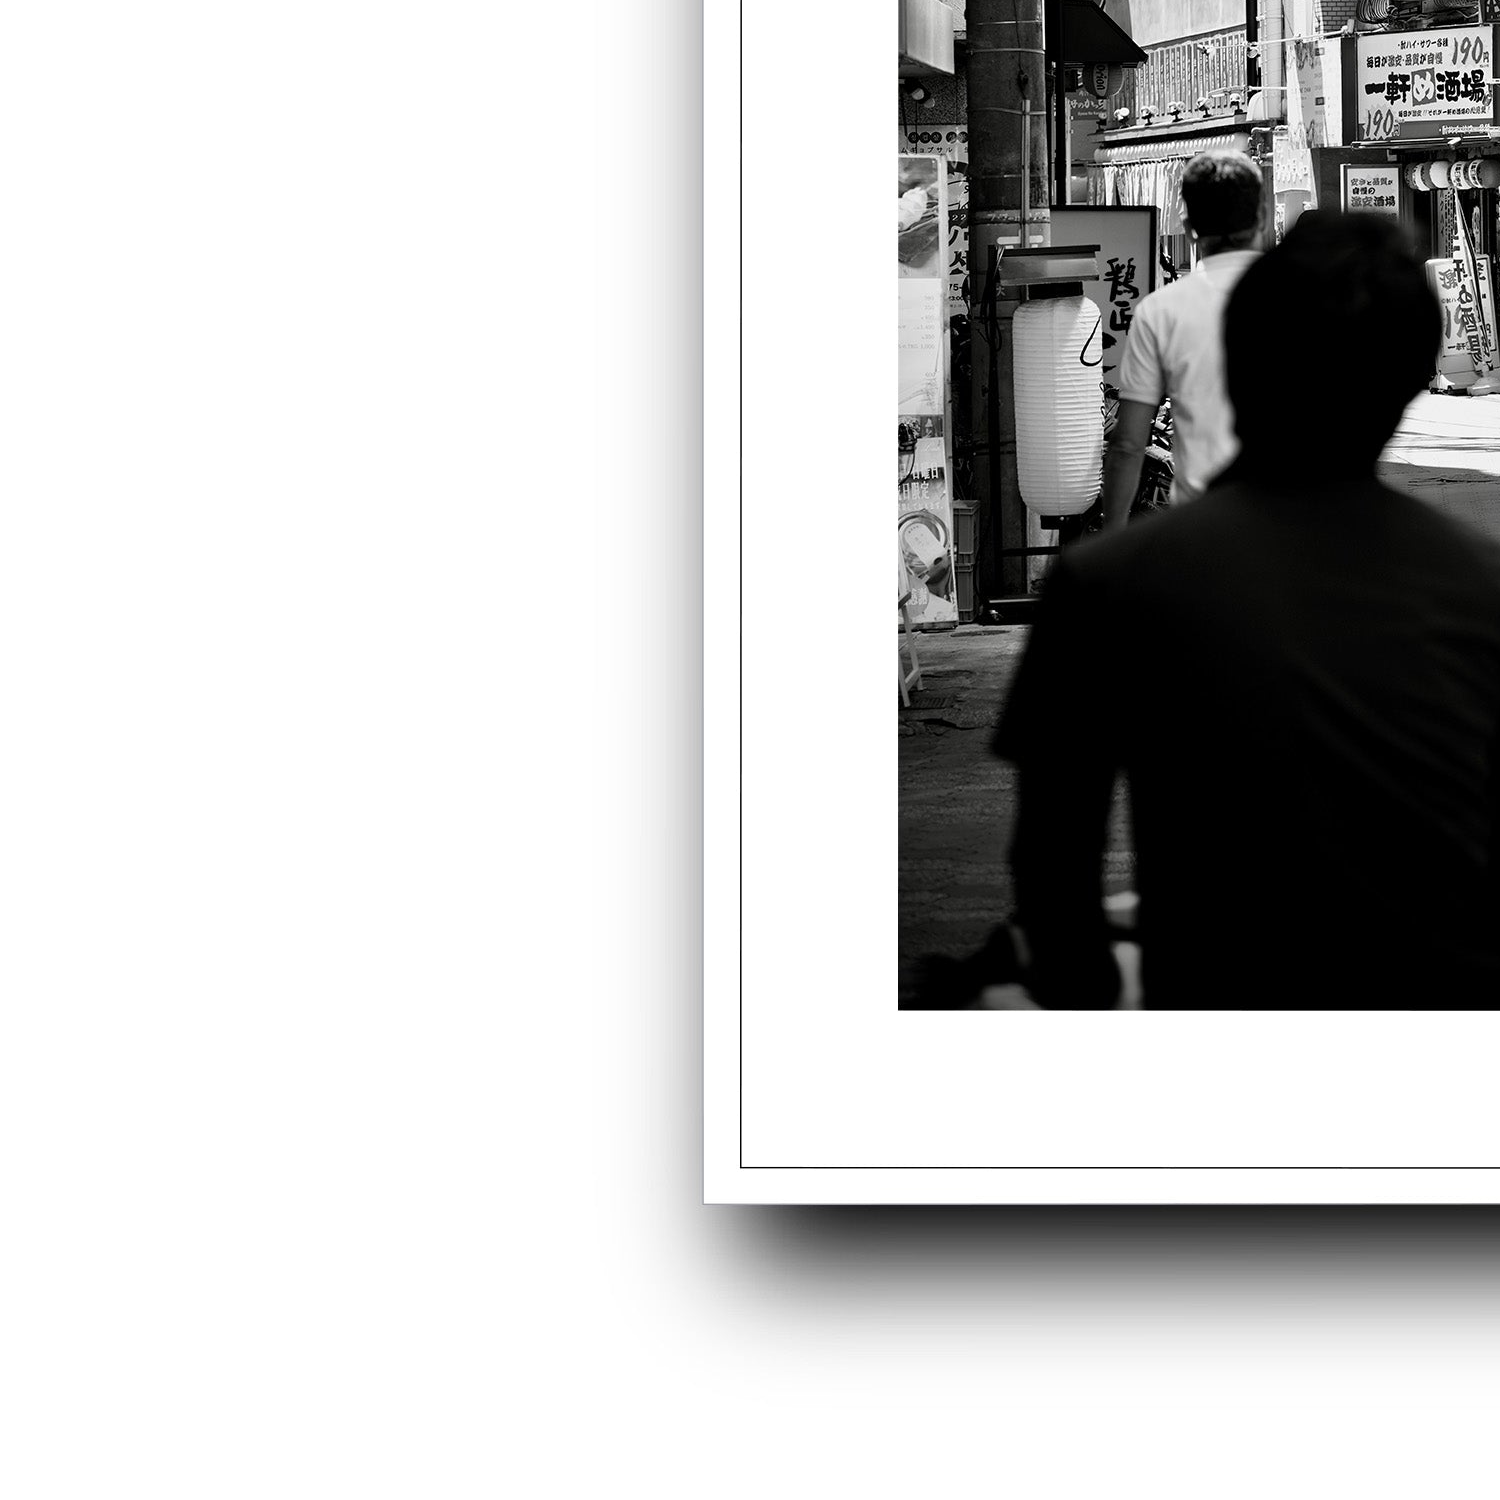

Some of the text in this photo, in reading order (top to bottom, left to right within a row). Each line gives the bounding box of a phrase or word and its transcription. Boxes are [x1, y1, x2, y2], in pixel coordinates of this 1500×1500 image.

[1365, 68, 1487, 107] 一軒め酒場
